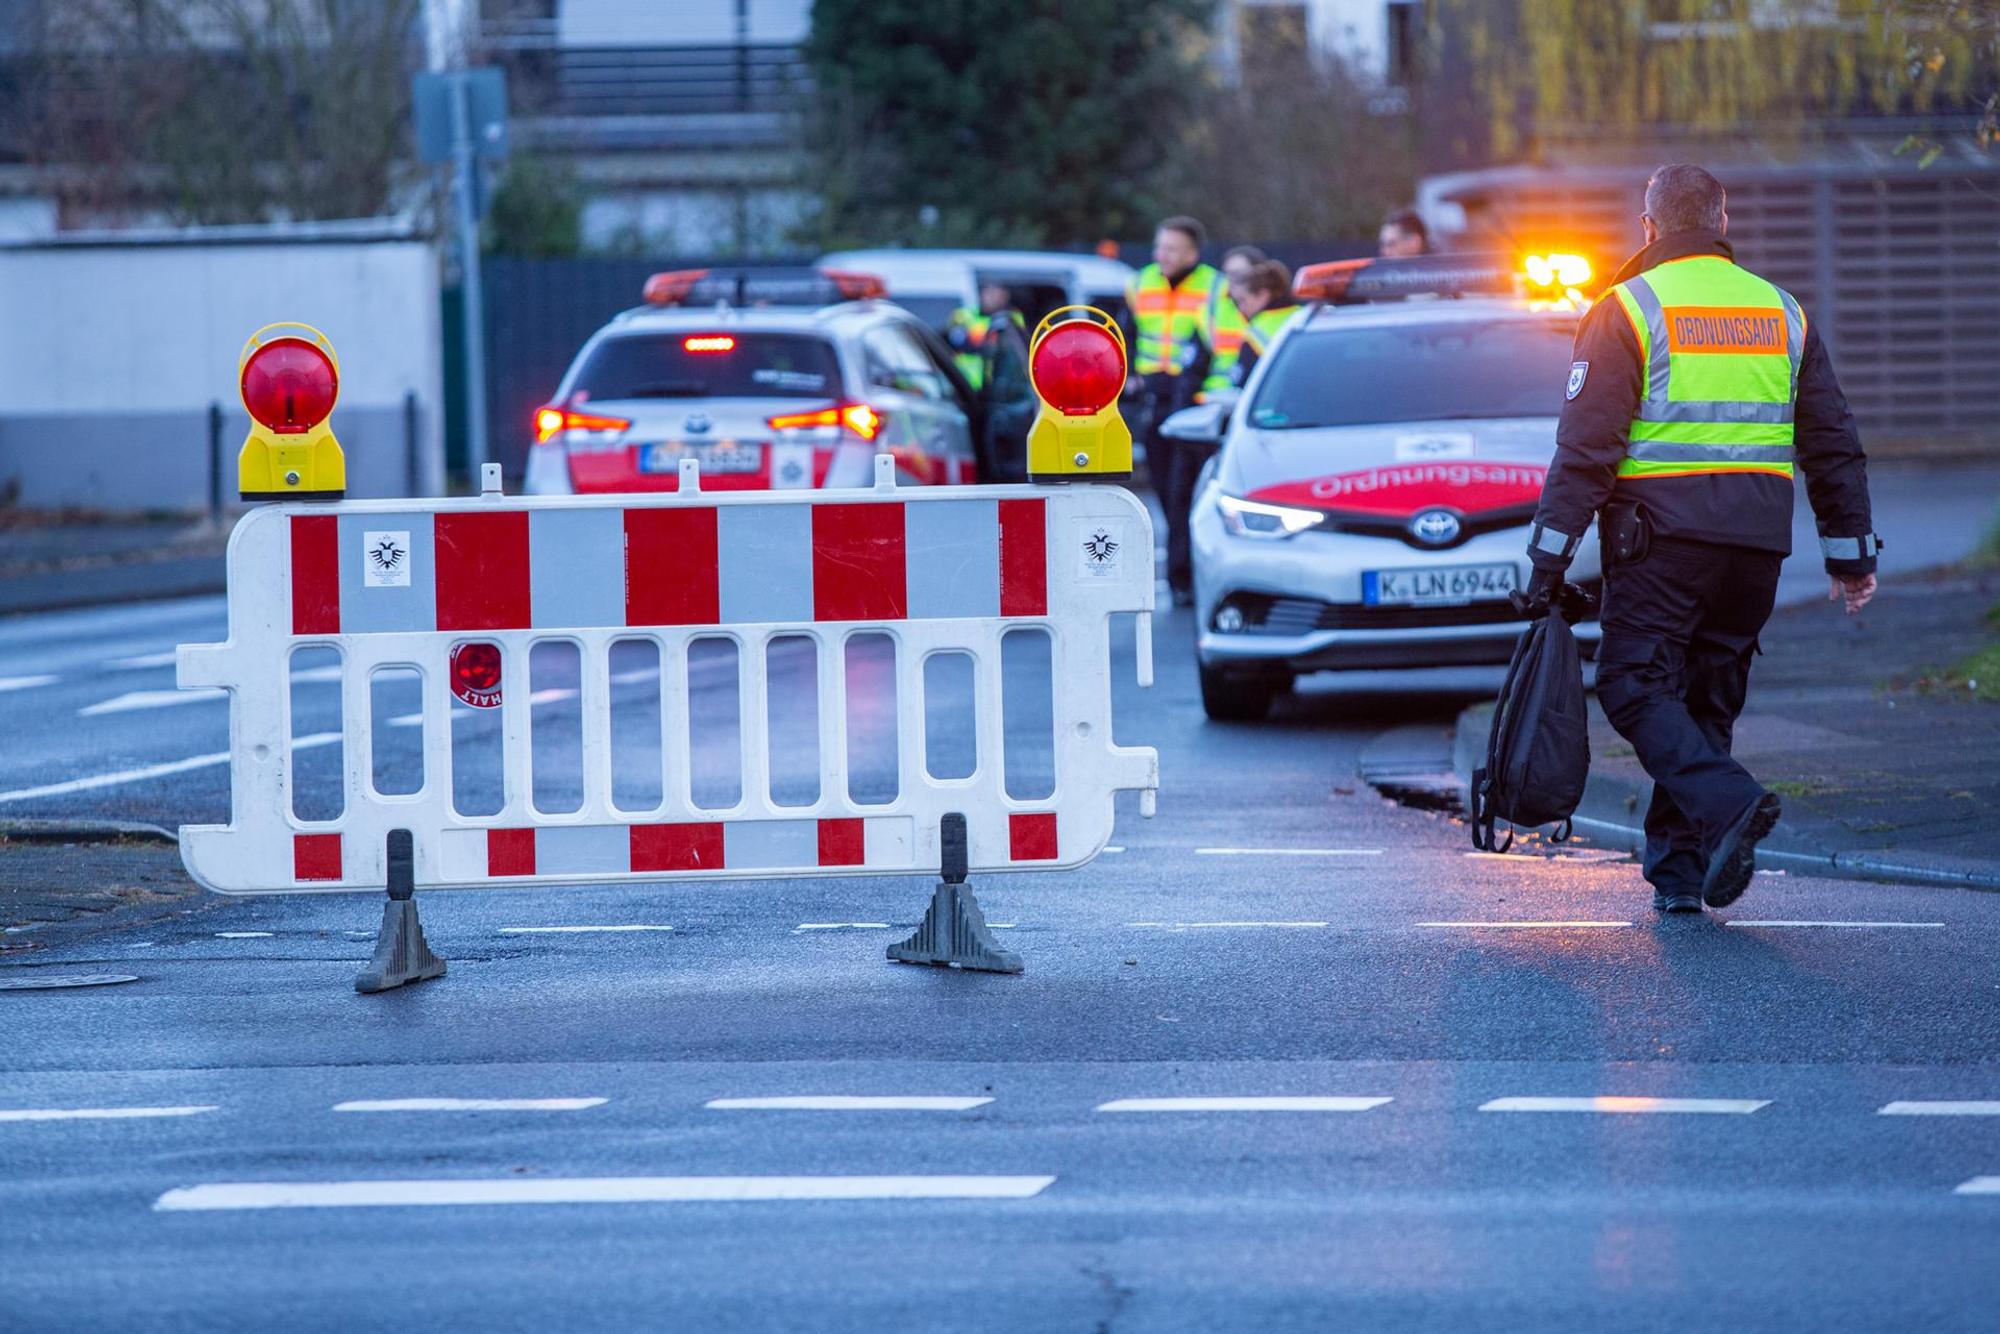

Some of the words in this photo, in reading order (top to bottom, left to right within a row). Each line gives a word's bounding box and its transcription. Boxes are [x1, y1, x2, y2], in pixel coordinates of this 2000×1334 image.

[1675, 316, 1781, 346] ORDNUNGSAMT
[1311, 464, 1544, 498] Ordnungsam
[461, 690, 502, 706] HALT
